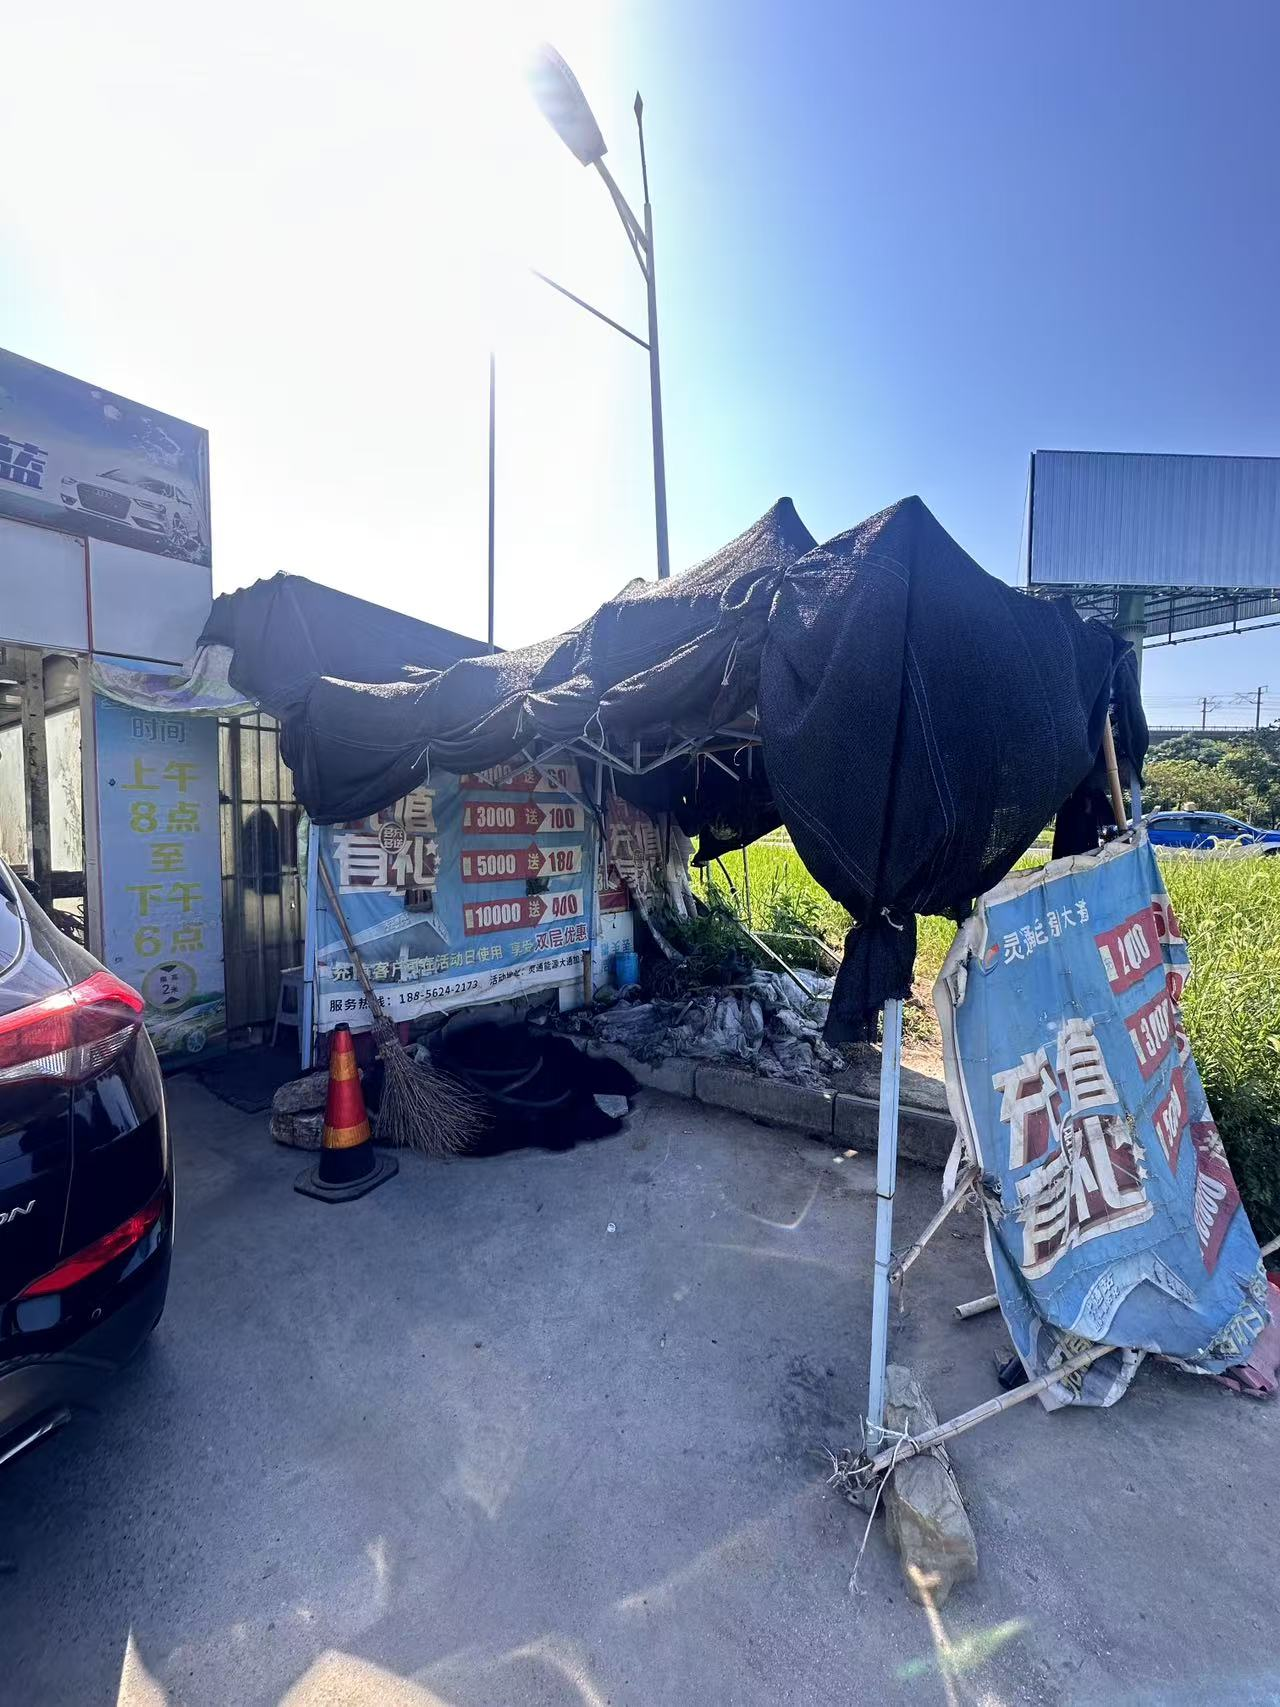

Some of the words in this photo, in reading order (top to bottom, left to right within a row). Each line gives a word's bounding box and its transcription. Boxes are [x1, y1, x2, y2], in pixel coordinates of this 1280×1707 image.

[131, 717, 186, 743] 时间
[120, 758, 200, 793] 上午
[130, 801, 201, 834] 8点
[476, 806, 516, 828] 3000
[525, 807, 539, 825] 送
[550, 807, 575, 829] 100
[149, 842, 185, 873] 至
[477, 853, 517, 876] 5000
[527, 852, 541, 871] 送
[548, 850, 574, 873] 180
[125, 882, 202, 917] 下午
[475, 902, 521, 928] 10000
[529, 900, 542, 918] 送
[134, 924, 205, 959] 6点
[399, 979, 478, 1005] 188-5624-2173
